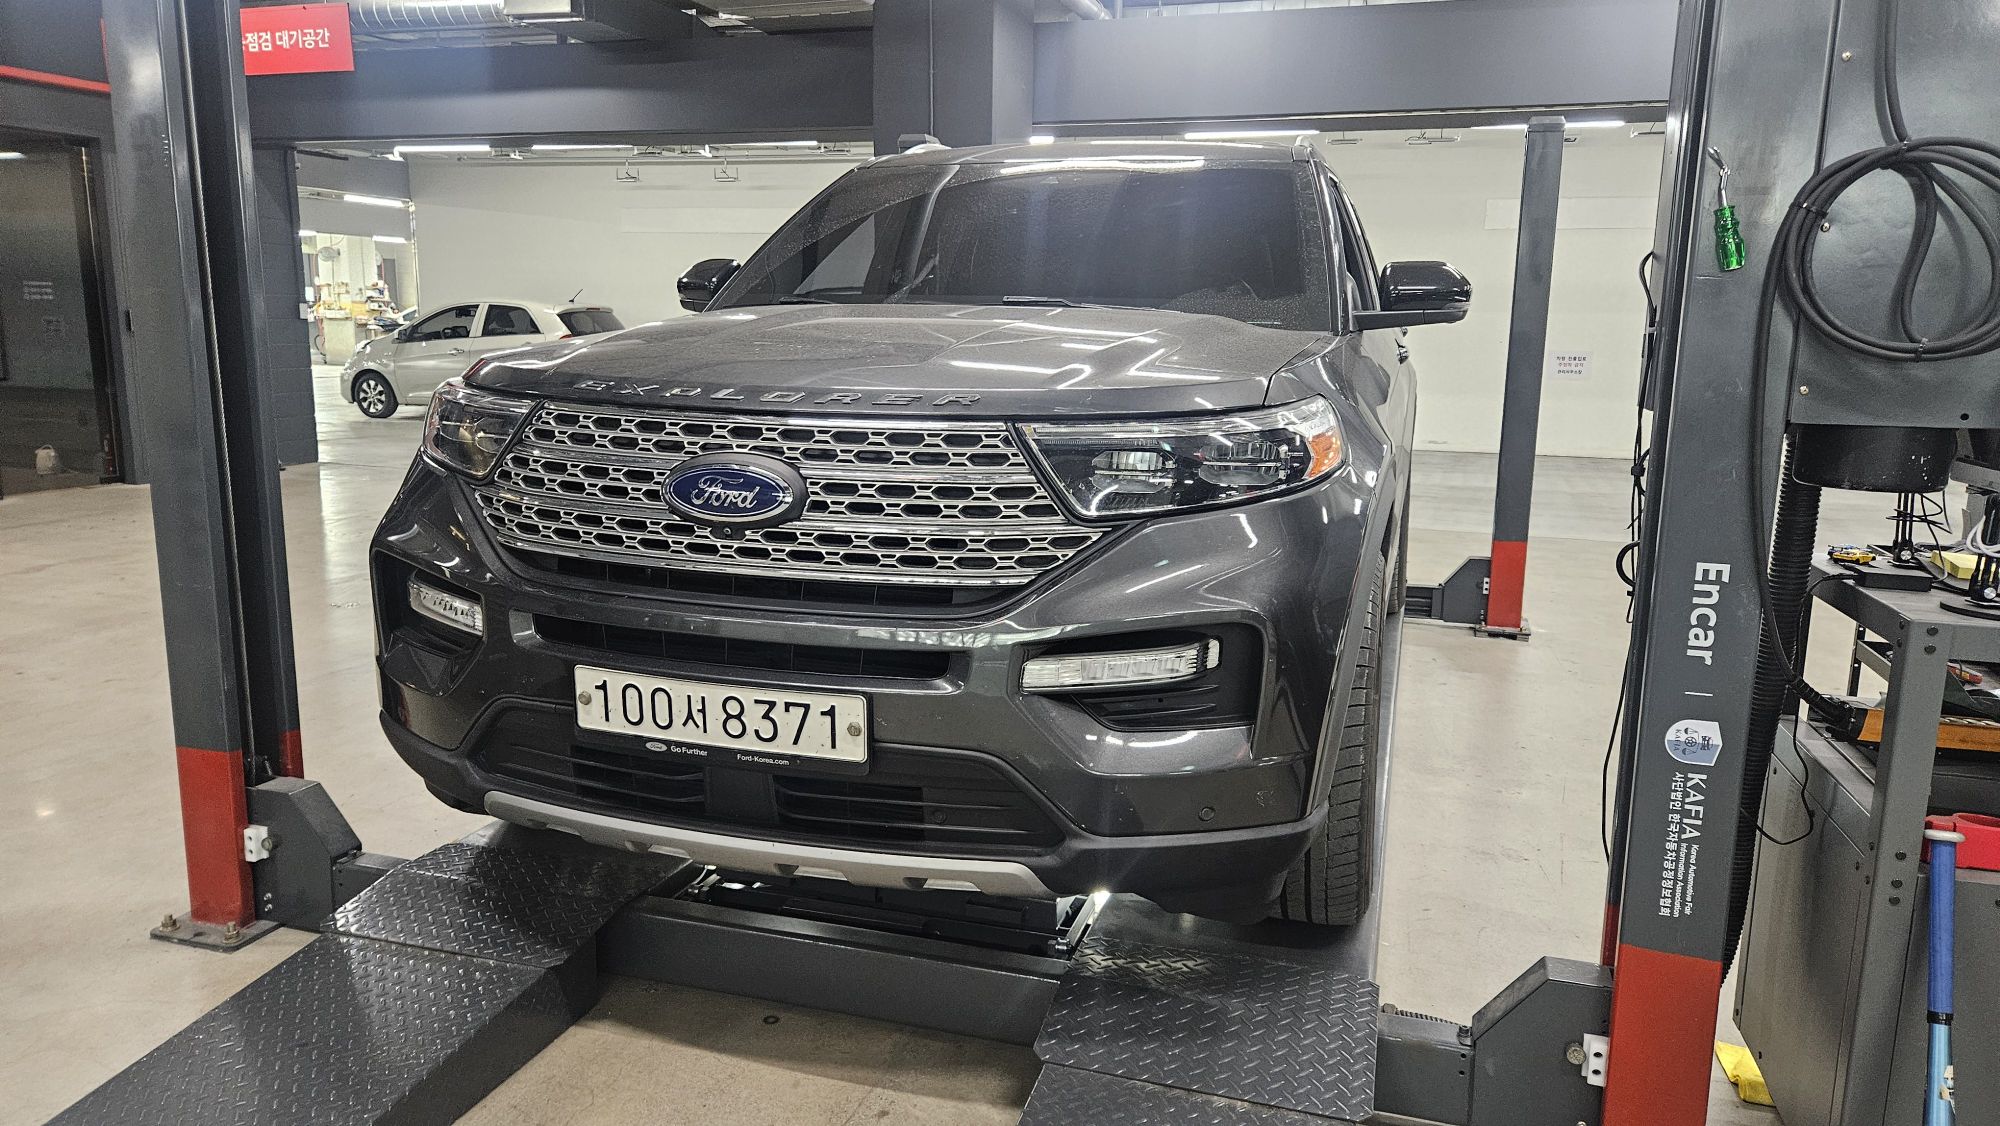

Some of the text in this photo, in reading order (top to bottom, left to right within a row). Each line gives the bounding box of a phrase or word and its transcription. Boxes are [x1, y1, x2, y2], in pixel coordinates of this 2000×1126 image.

[242, 28, 330, 52] 점검 대기공간
[573, 379, 982, 406] EXPLORER
[691, 475, 760, 510] Ford
[1686, 562, 1731, 666] Encar
[594, 679, 837, 750] 100서 8371
[670, 745, 708, 756] Go Further
[737, 753, 790, 766] Ford-Korea.com
[1681, 772, 1707, 839] KAFIA
[1659, 771, 1685, 917] 사단법인 한국자동차공정정보협회
[1673, 843, 1688, 918] Information Association
[1684, 844, 1700, 916] Korea Automotive Fair
